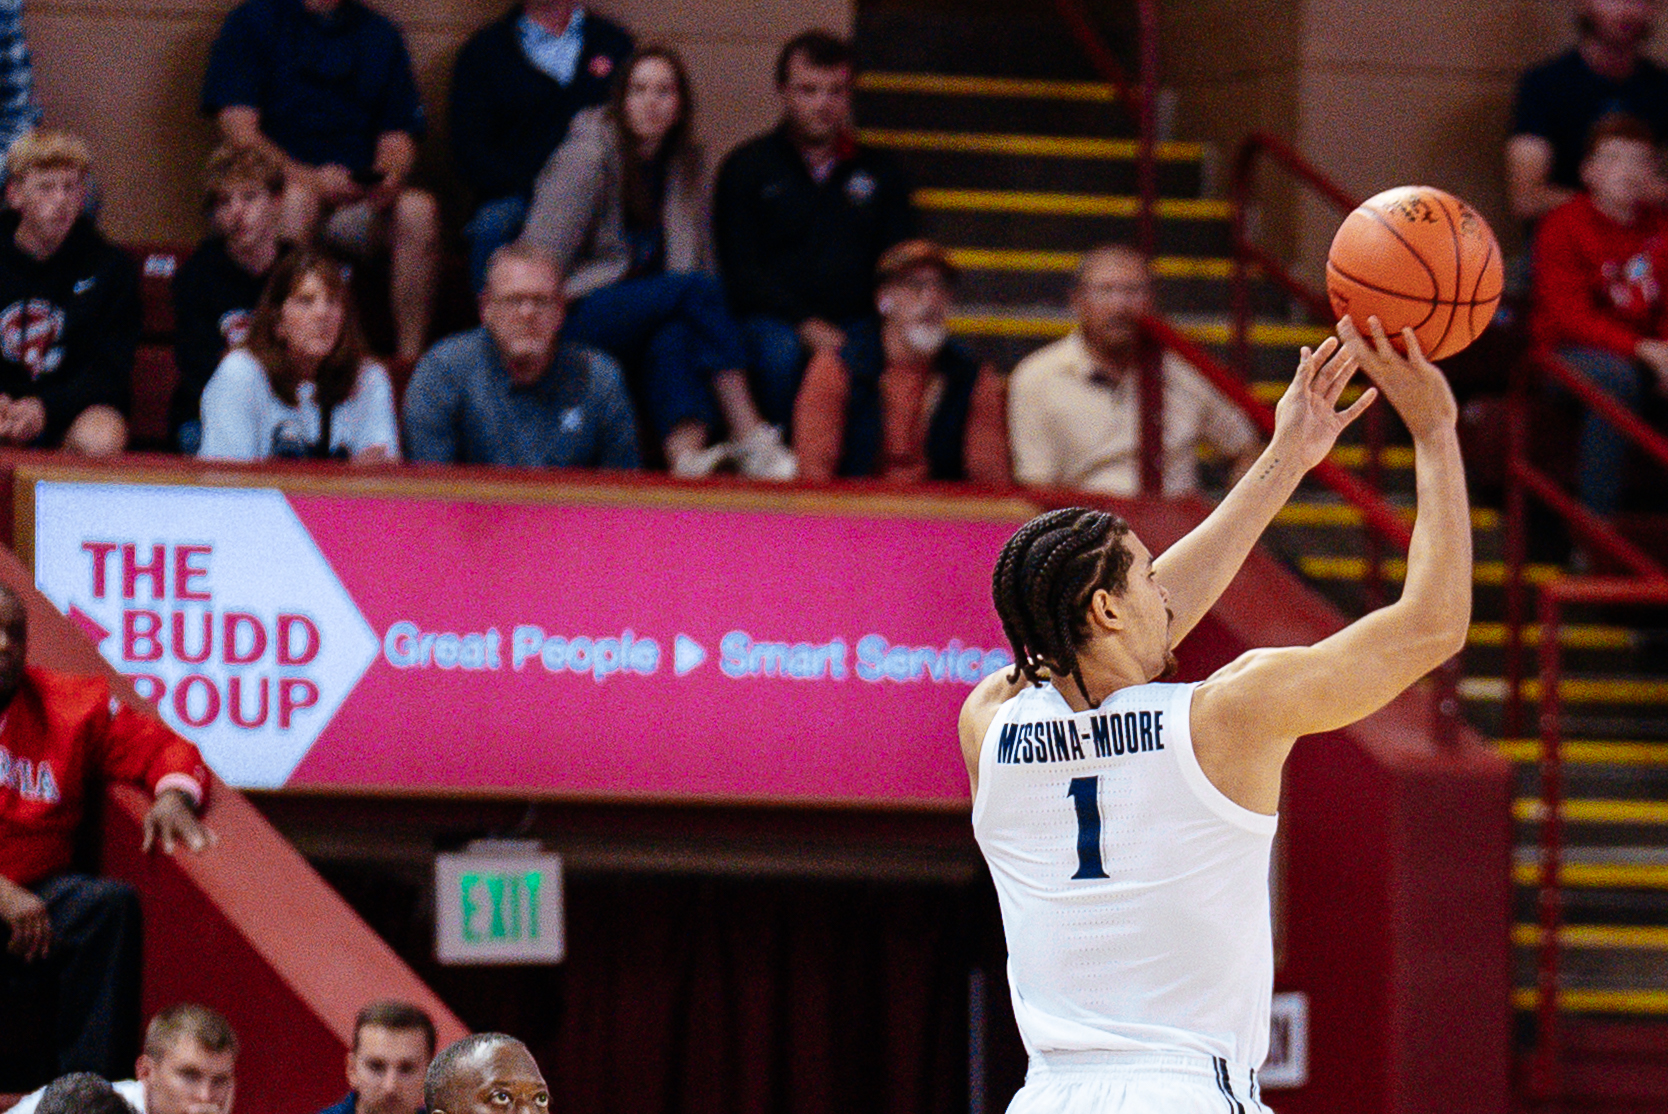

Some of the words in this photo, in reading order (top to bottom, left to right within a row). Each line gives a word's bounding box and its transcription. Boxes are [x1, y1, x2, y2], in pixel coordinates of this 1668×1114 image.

[81, 540, 213, 600] THE
[121, 608, 322, 667] BUDD
[384, 620, 501, 669] Great
[512, 624, 661, 682] People
[720, 630, 845, 679] Smart
[996, 710, 1166, 764] MESSINA-MOORE
[1066, 775, 1111, 880] 1
[460, 871, 543, 943] EXIT
